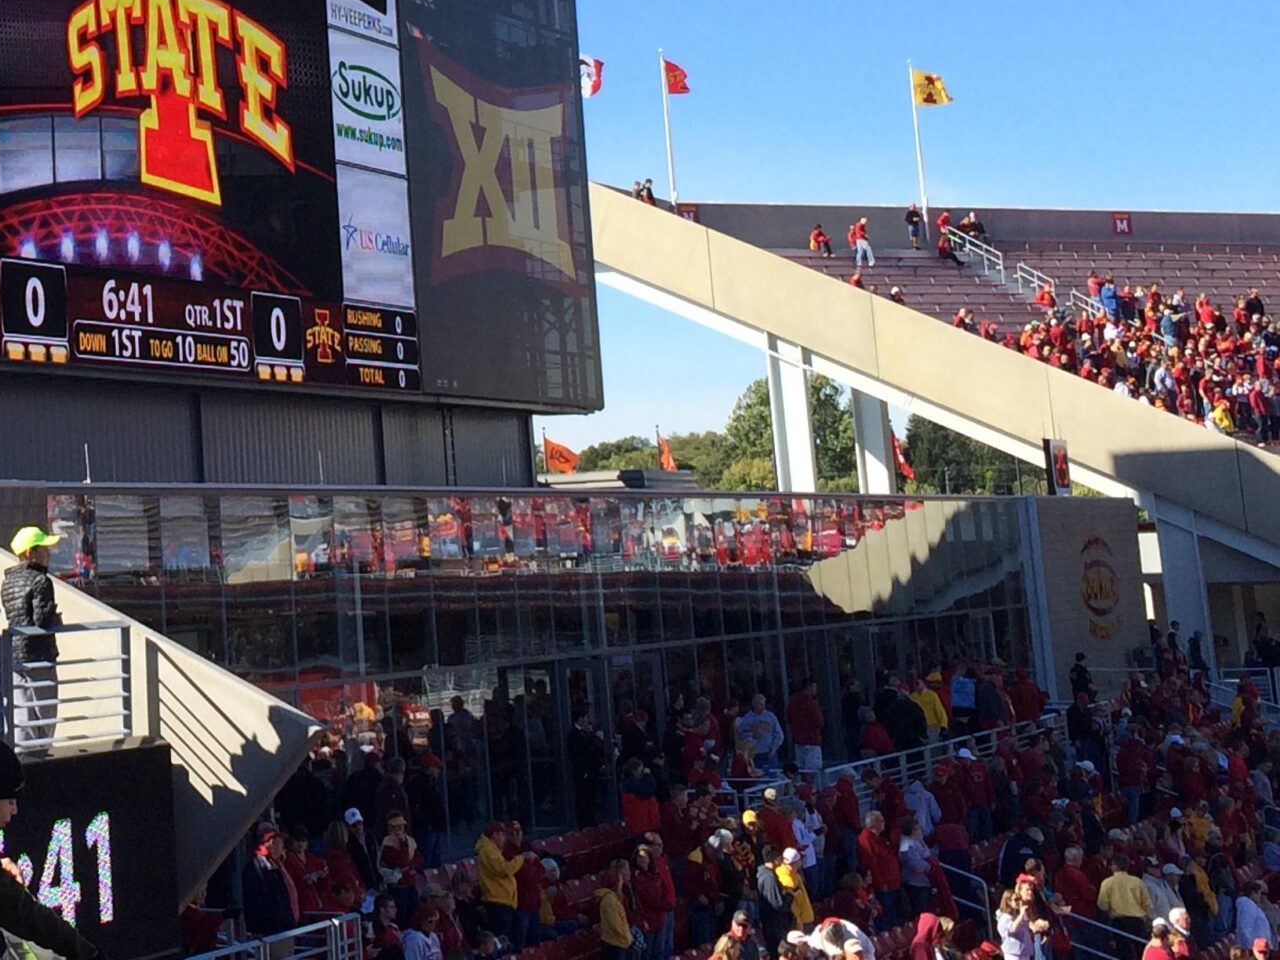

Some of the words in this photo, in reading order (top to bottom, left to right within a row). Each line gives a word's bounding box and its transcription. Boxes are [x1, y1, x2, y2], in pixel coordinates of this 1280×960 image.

[337, 60, 395, 121] Sukup
[336, 122, 404, 153] www.sukup.com
[24, 276, 46, 328] 0
[101, 279, 154, 324] 6:41
[184, 303, 213, 328] QTR.
[213, 297, 245, 331] 1ST
[269, 306, 287, 351] 0
[346, 308, 382, 329] RUSHING
[395, 315, 402, 335] 0
[78, 331, 107, 353] DOWN
[111, 328, 142, 358] 1ST
[149, 338, 160, 358] TO
[161, 339, 174, 359] GO
[176, 335, 196, 363] 10
[196, 343, 216, 363] BALL
[216, 345, 228, 363] ON
[230, 340, 249, 368] 50
[305, 325, 342, 353] STATE
[348, 335, 382, 355] PASSING
[396, 341, 404, 361] 0
[359, 367, 385, 385] TOTAL
[398, 369, 406, 389] 0
